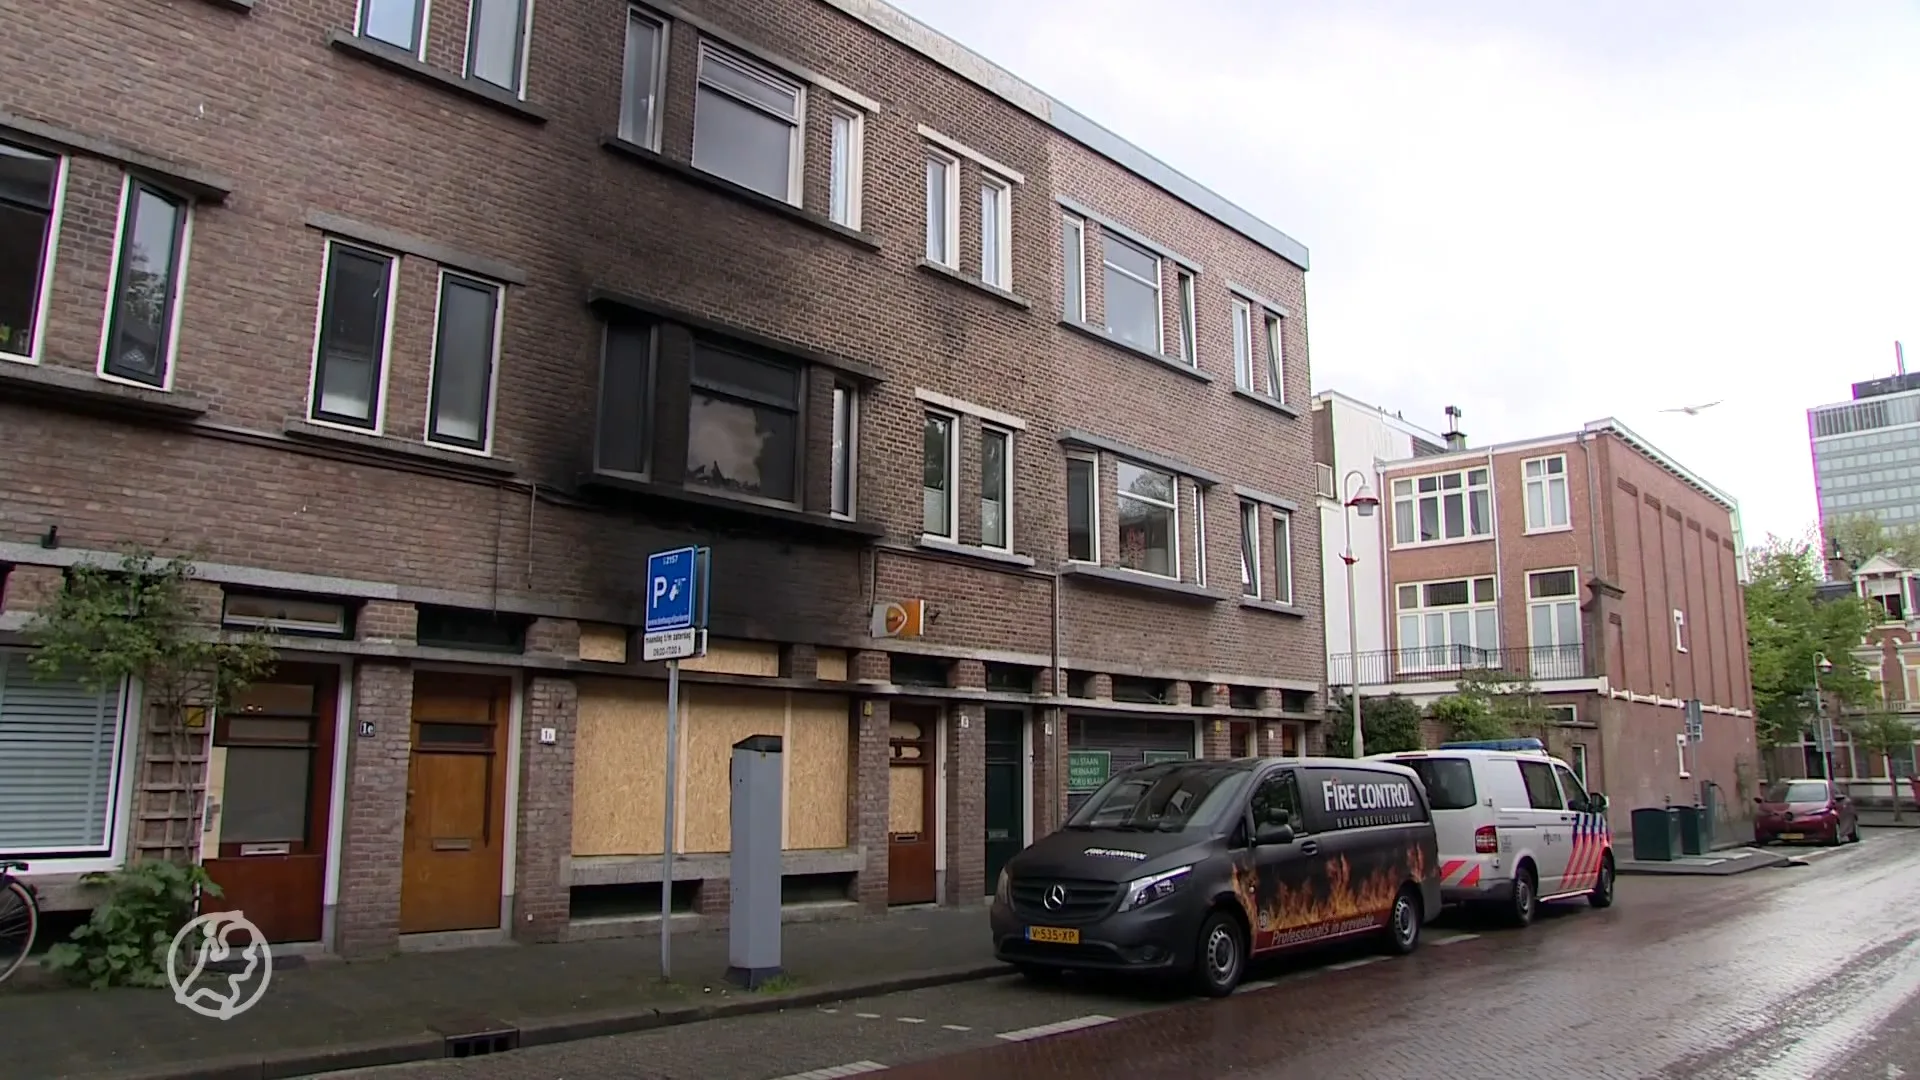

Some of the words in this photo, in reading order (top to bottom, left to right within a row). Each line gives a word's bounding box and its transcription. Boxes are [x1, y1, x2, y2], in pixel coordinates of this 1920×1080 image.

[653, 576, 667, 608] P
[1322, 781, 1358, 811] FIRE
[1358, 783, 1414, 809] CONTROL
